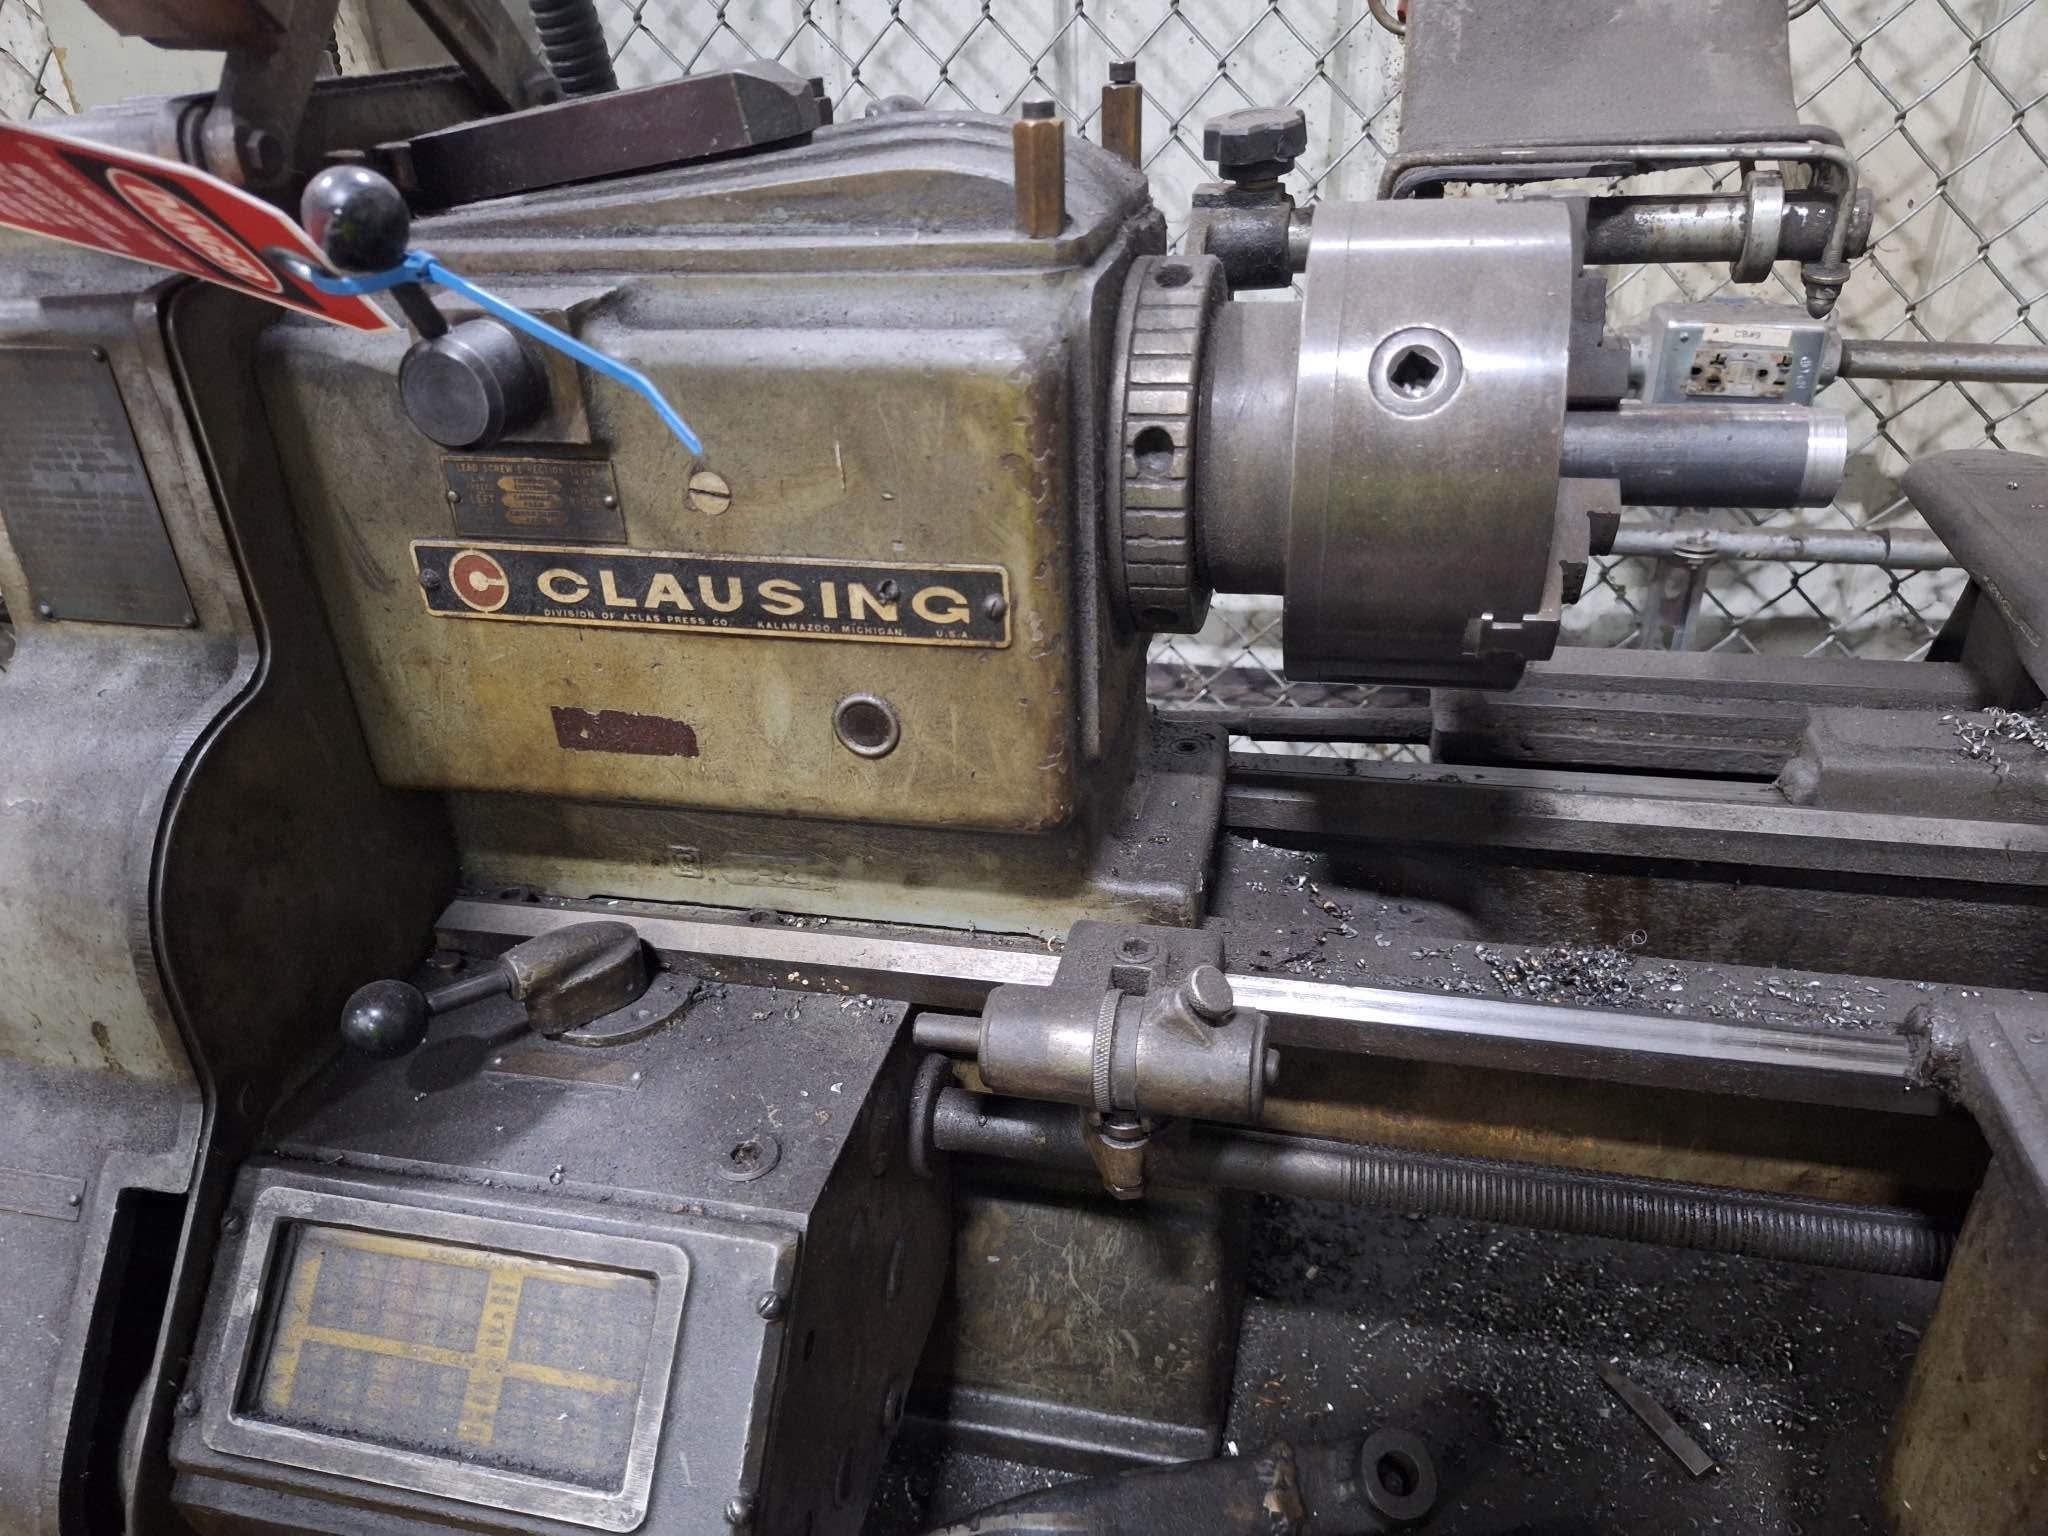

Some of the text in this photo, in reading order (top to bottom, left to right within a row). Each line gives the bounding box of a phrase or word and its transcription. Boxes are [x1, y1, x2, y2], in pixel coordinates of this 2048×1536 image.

[536, 567, 970, 625] CLAUSING
[543, 608, 595, 620] DIVISION
[623, 613, 661, 623] ATLAS
[667, 615, 706, 626] PRESS
